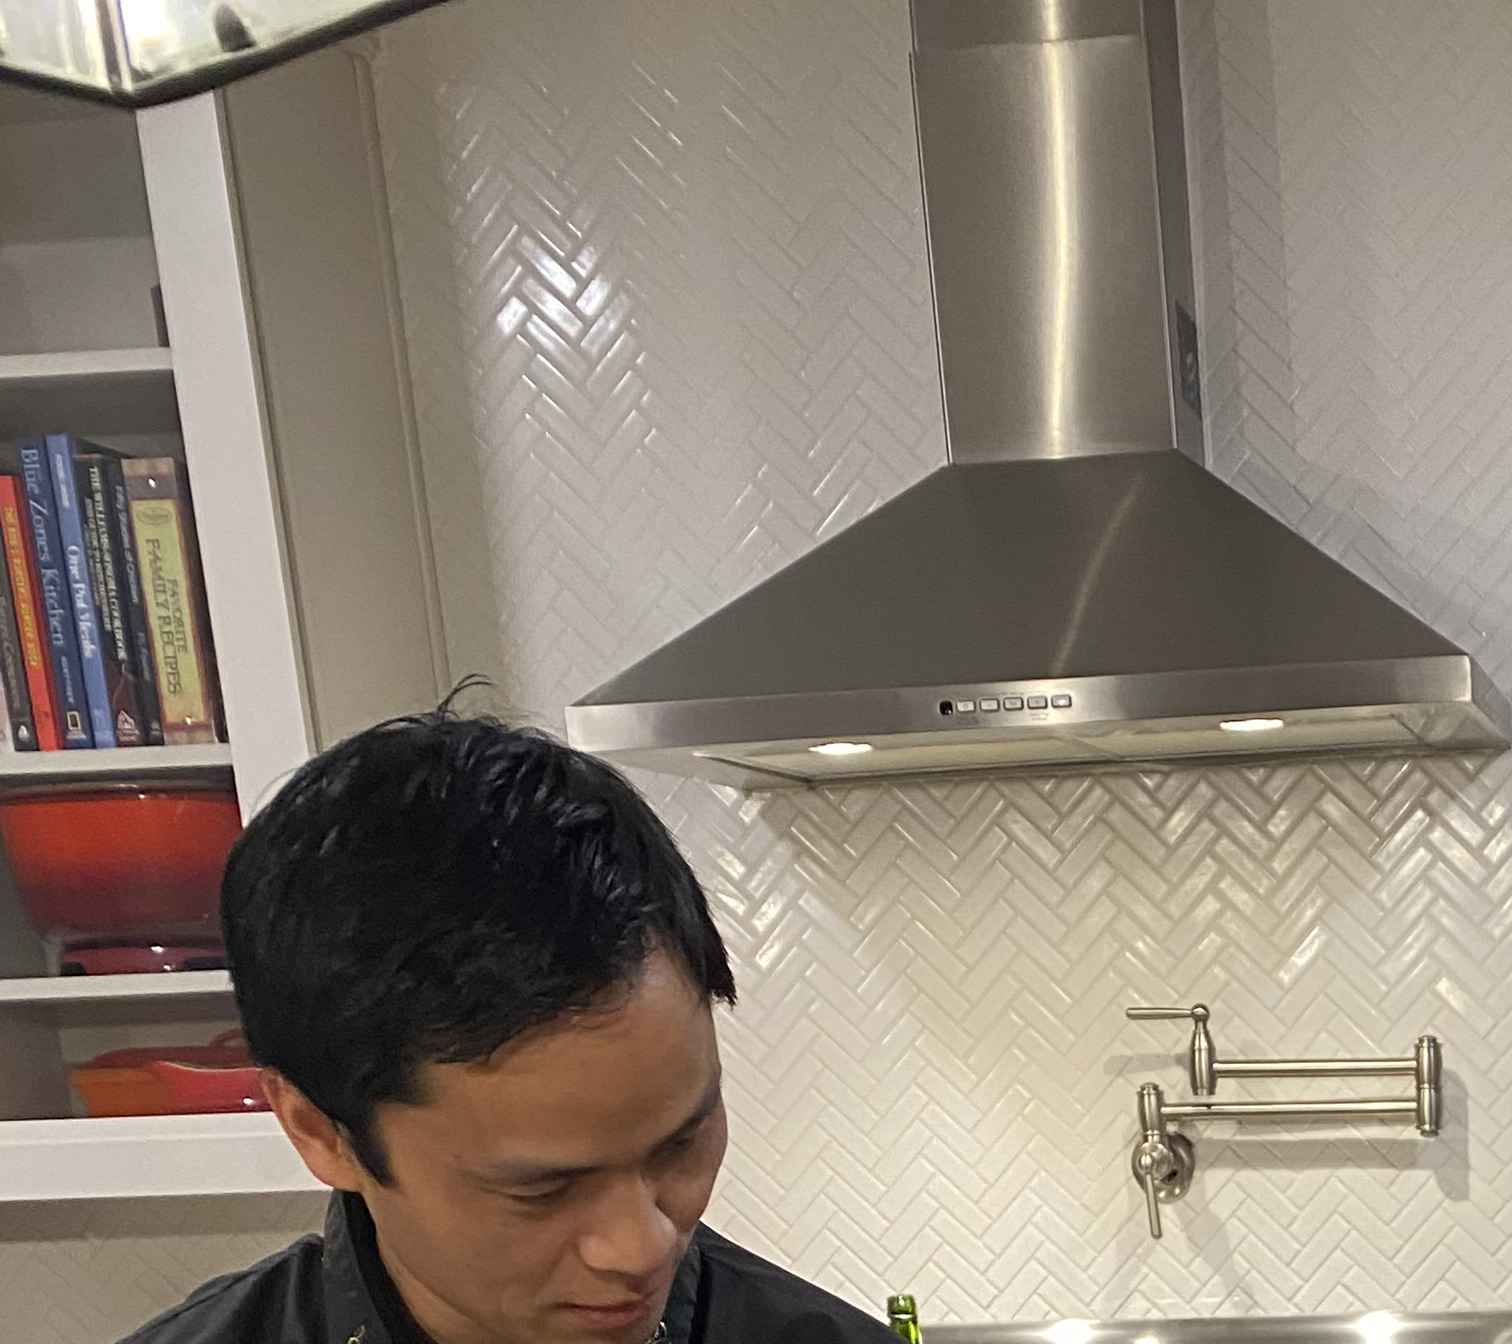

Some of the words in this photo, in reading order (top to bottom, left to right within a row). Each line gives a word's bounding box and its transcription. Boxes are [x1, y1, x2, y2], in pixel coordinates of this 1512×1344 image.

[20, 448, 41, 495] Blue
[28, 498, 51, 561] Zones
[41, 567, 65, 646] Kitchen
[145, 537, 172, 612] FAMILY
[157, 614, 184, 695] RECIPES
